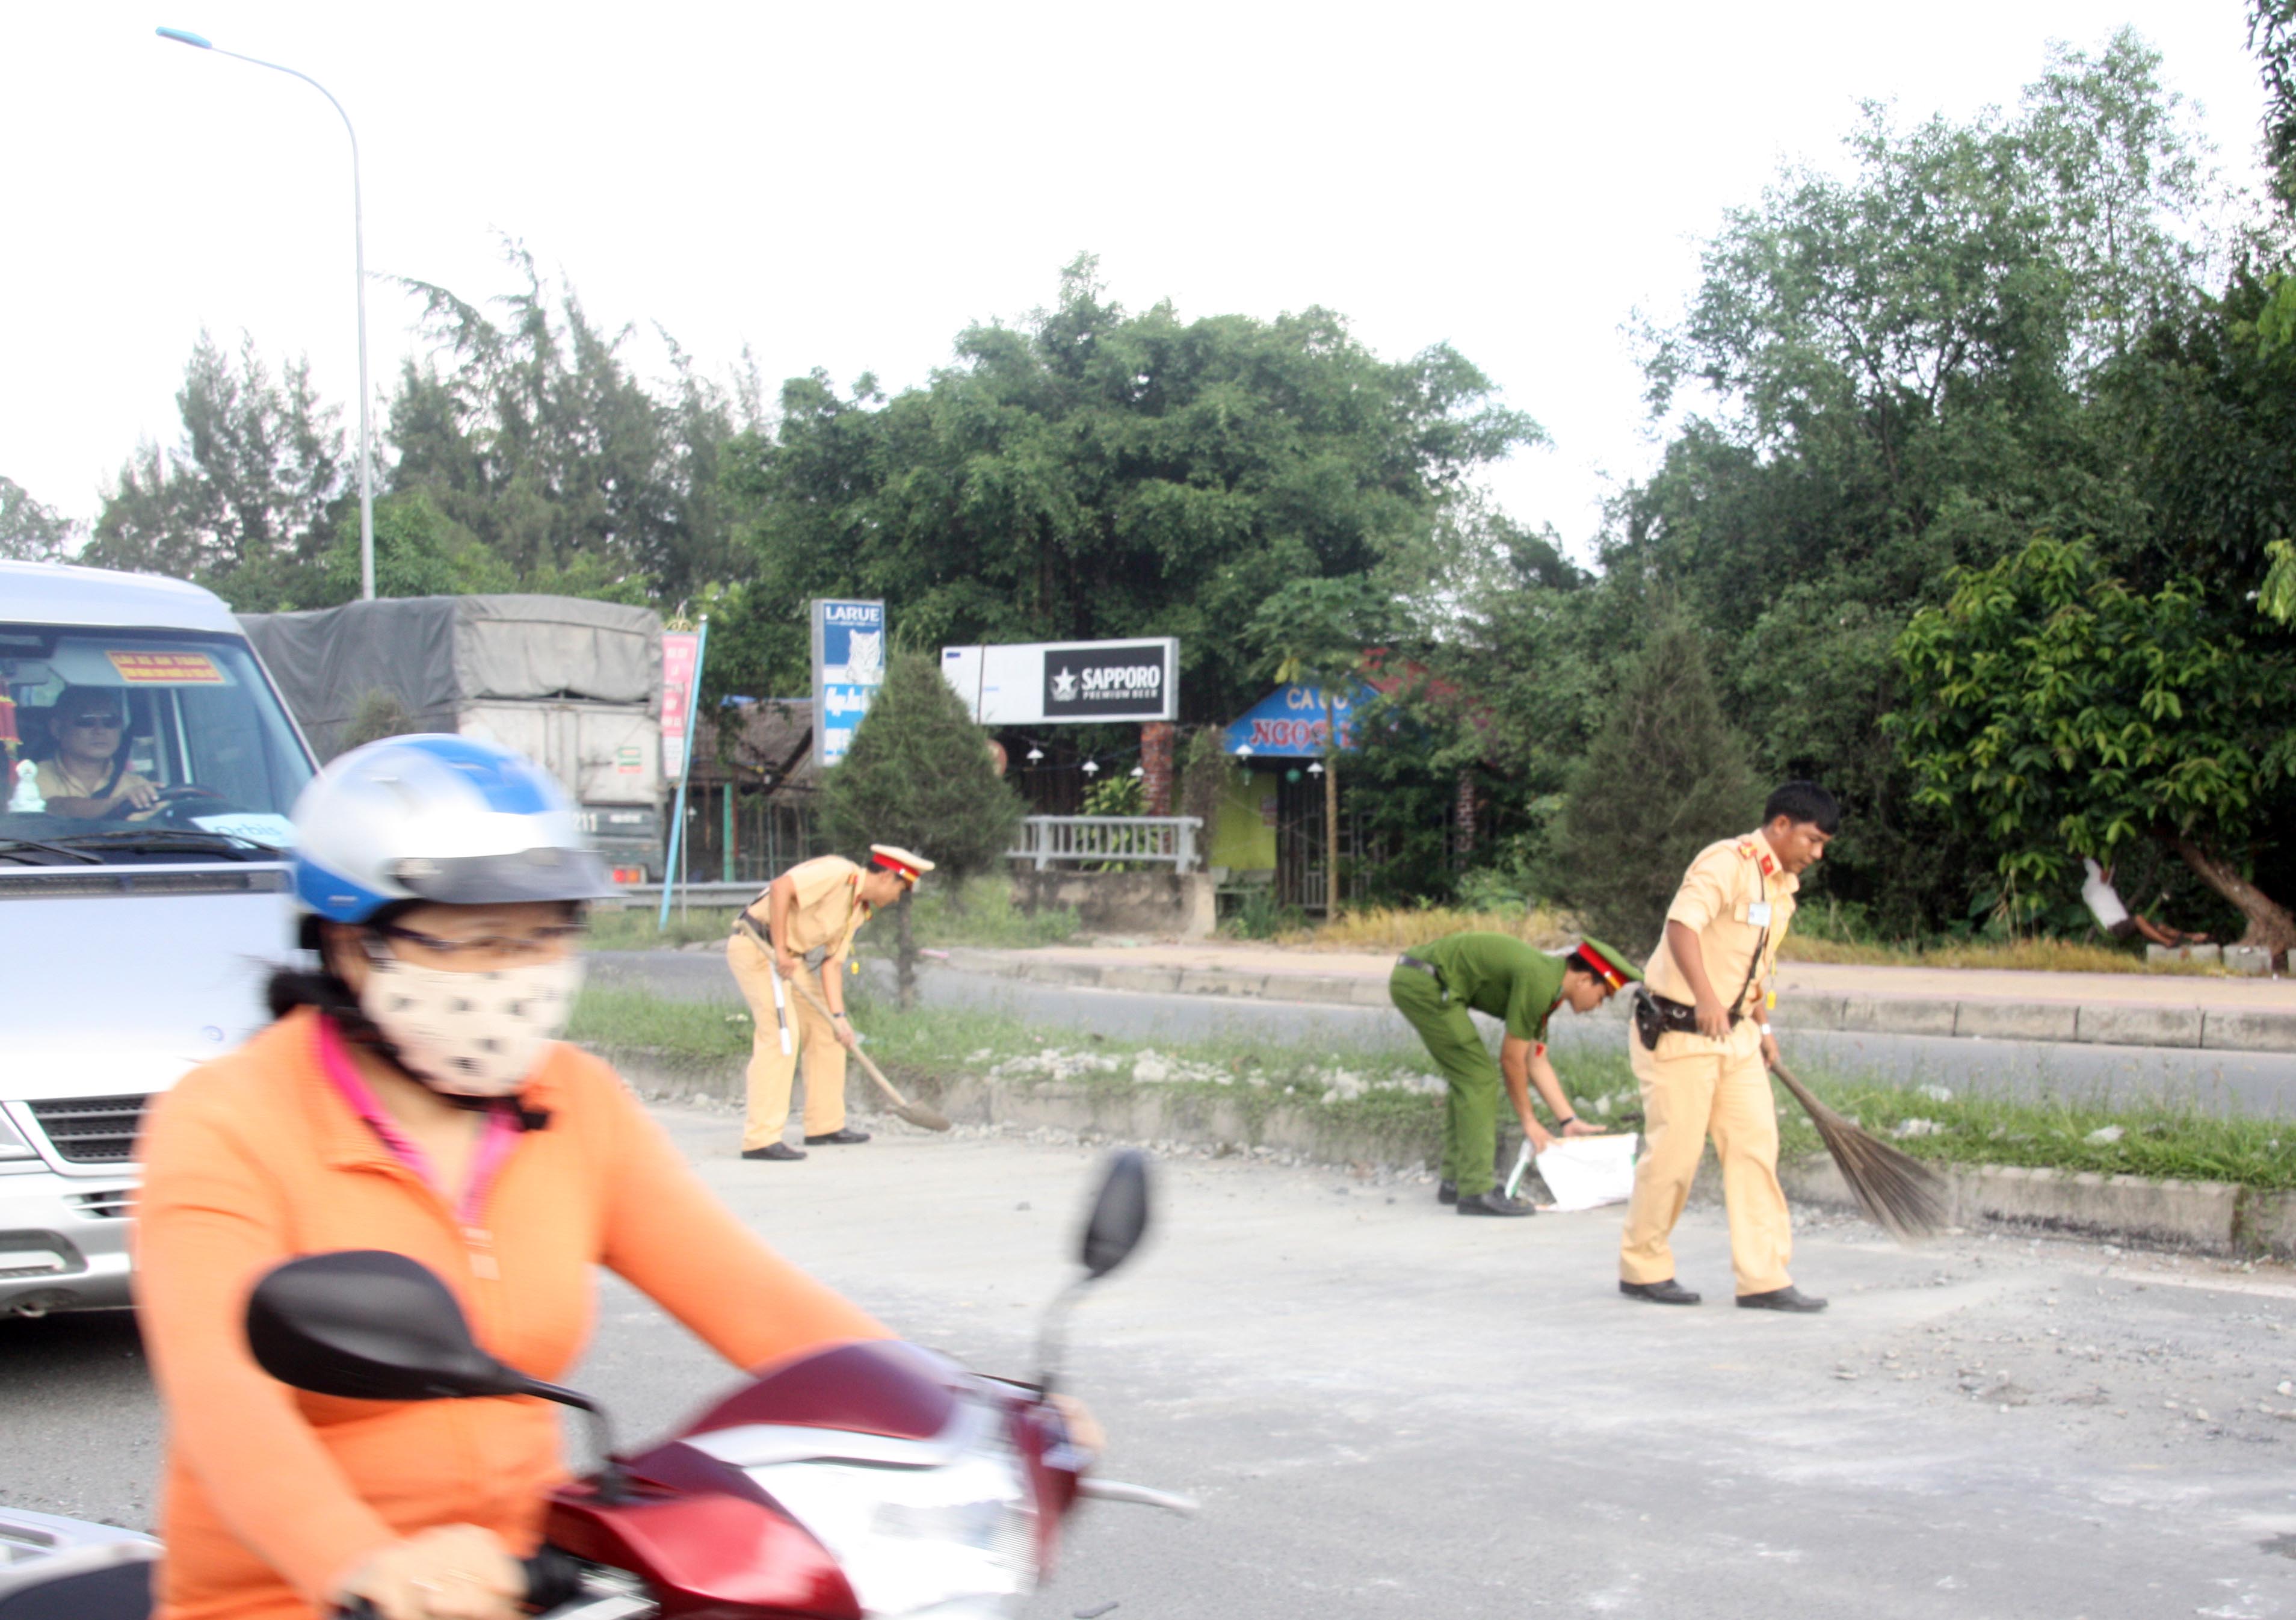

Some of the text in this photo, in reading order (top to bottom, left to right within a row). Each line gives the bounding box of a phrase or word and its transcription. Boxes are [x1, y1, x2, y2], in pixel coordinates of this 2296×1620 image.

[825, 605, 880, 622] LARUE
[1081, 664, 1161, 690] SAPPORO
[1083, 688, 1158, 700] PREMIUM BEER
